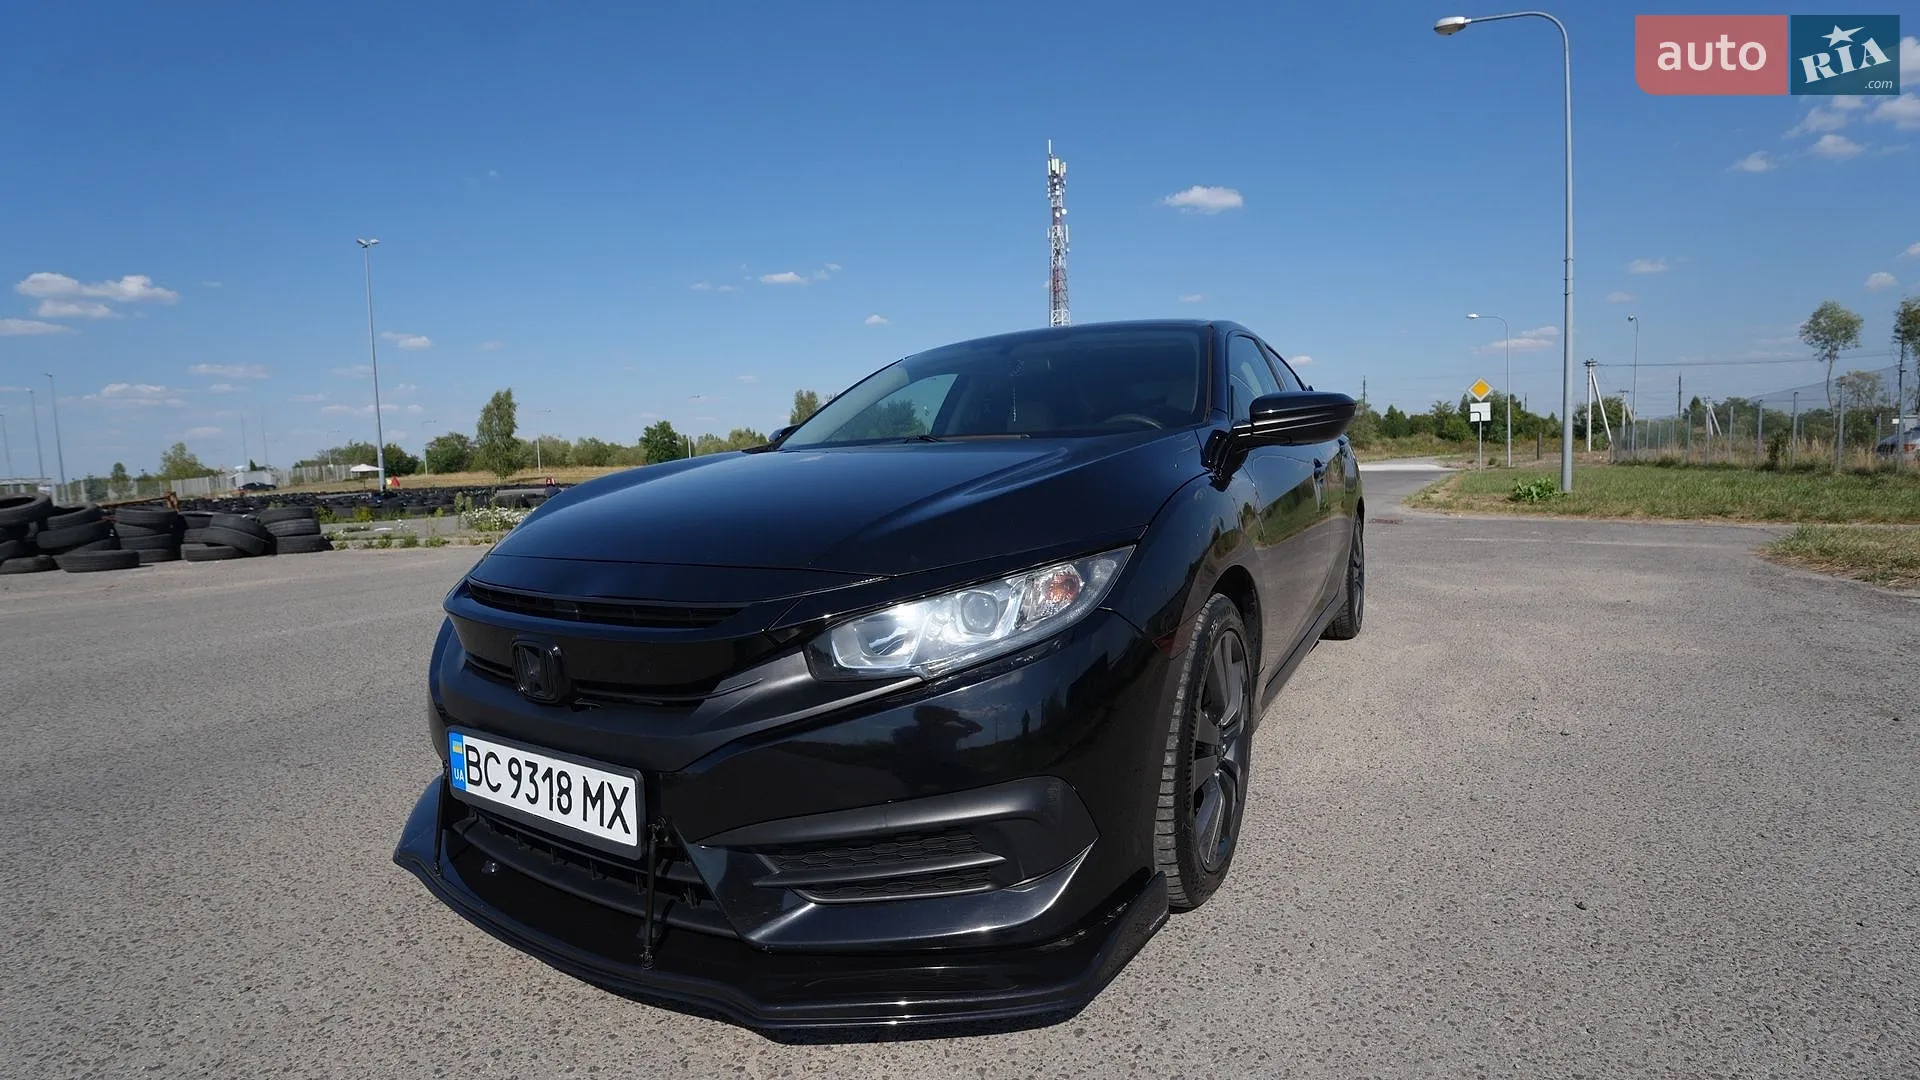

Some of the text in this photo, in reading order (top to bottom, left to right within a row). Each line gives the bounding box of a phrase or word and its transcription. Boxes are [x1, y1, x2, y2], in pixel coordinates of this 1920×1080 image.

[454, 769, 465, 782] UA
[465, 744, 631, 835] BC 9318 MX
